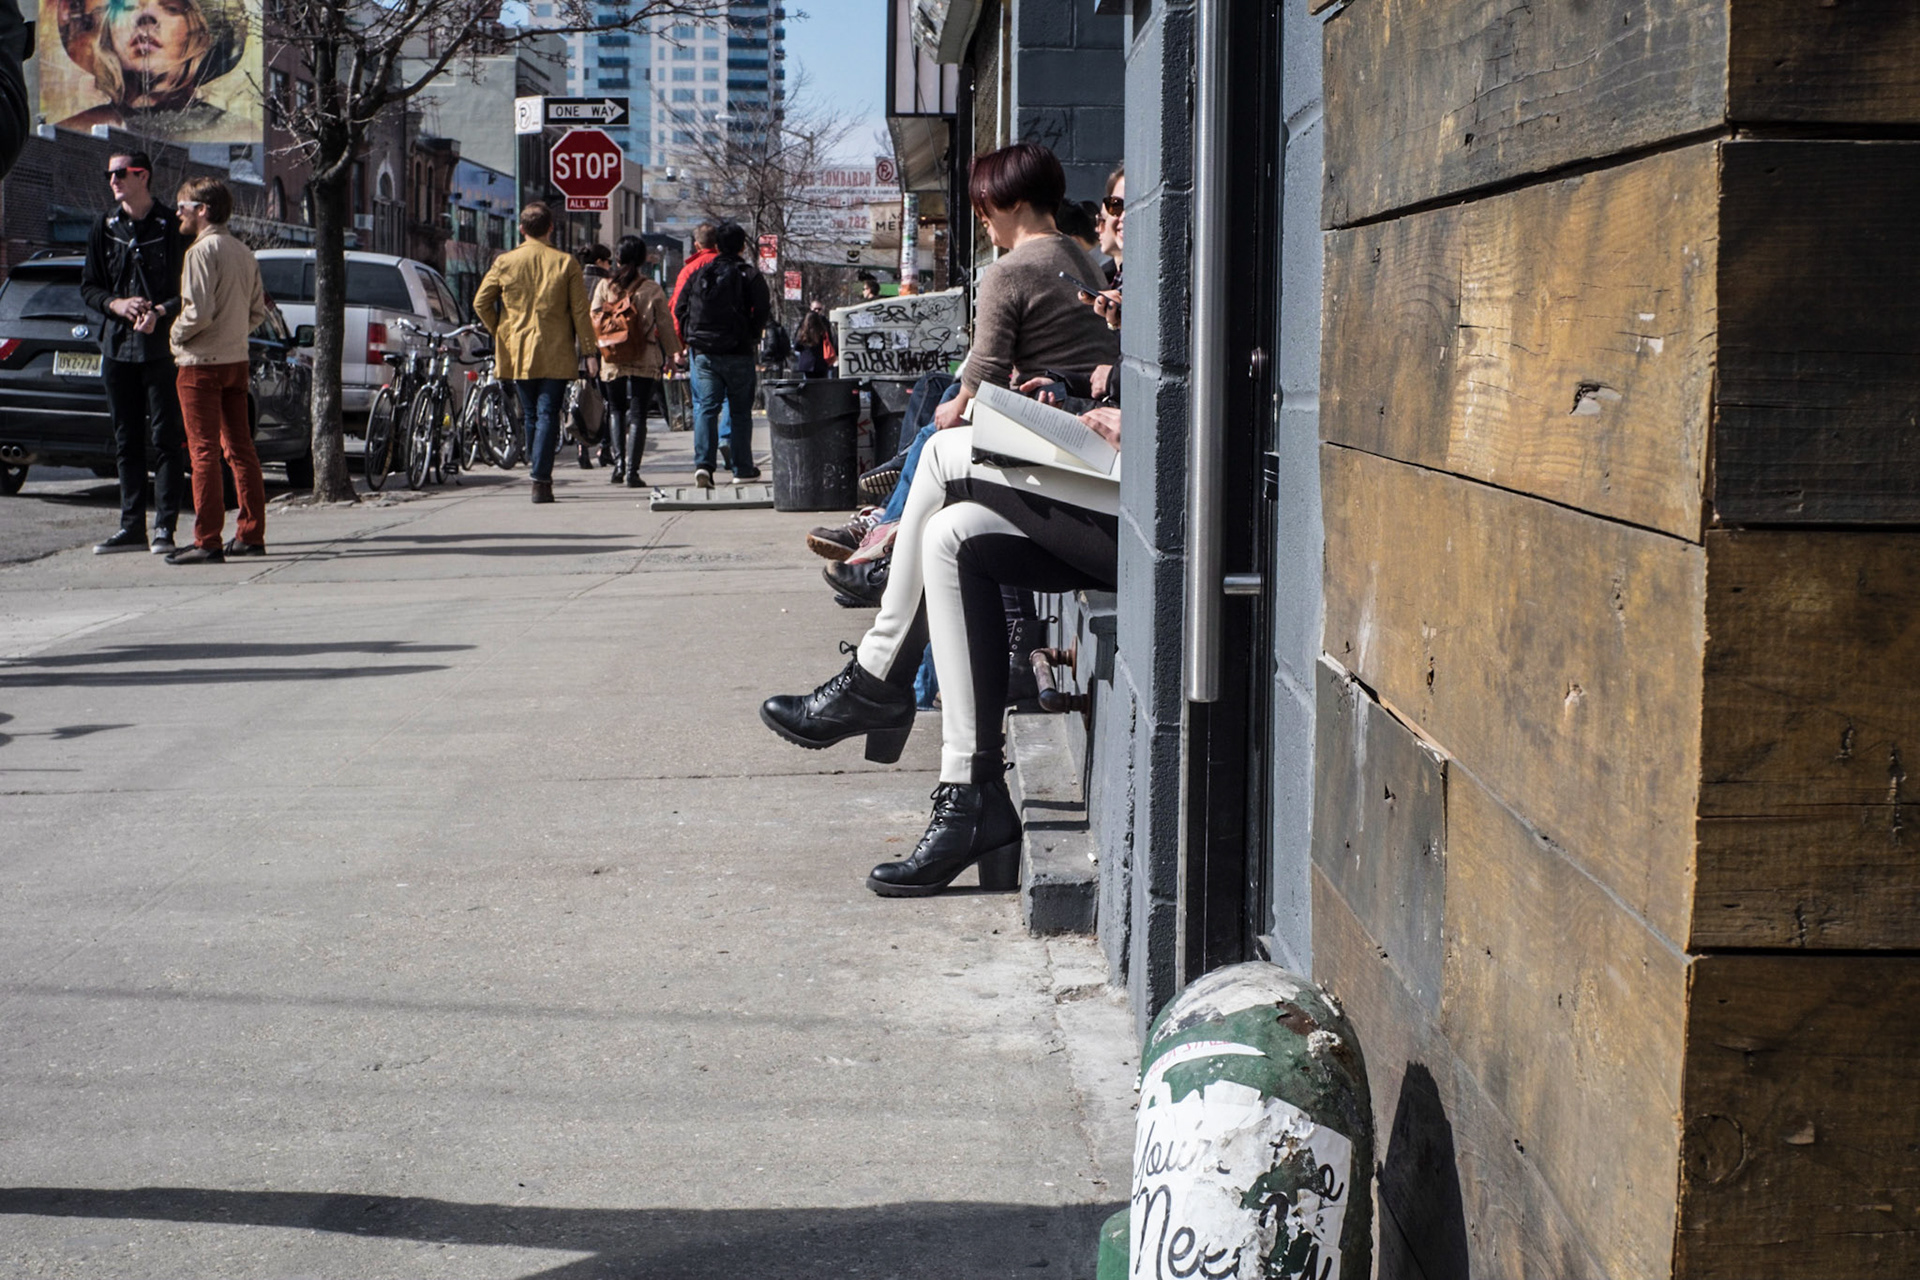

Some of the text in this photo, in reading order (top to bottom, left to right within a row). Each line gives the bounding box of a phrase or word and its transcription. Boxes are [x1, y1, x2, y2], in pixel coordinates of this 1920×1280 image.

[555, 105, 617, 117] ONE WAY
[555, 152, 618, 179] STOP
[820, 168, 871, 187] LOMBARDO
[569, 199, 607, 208] ALL WAY
